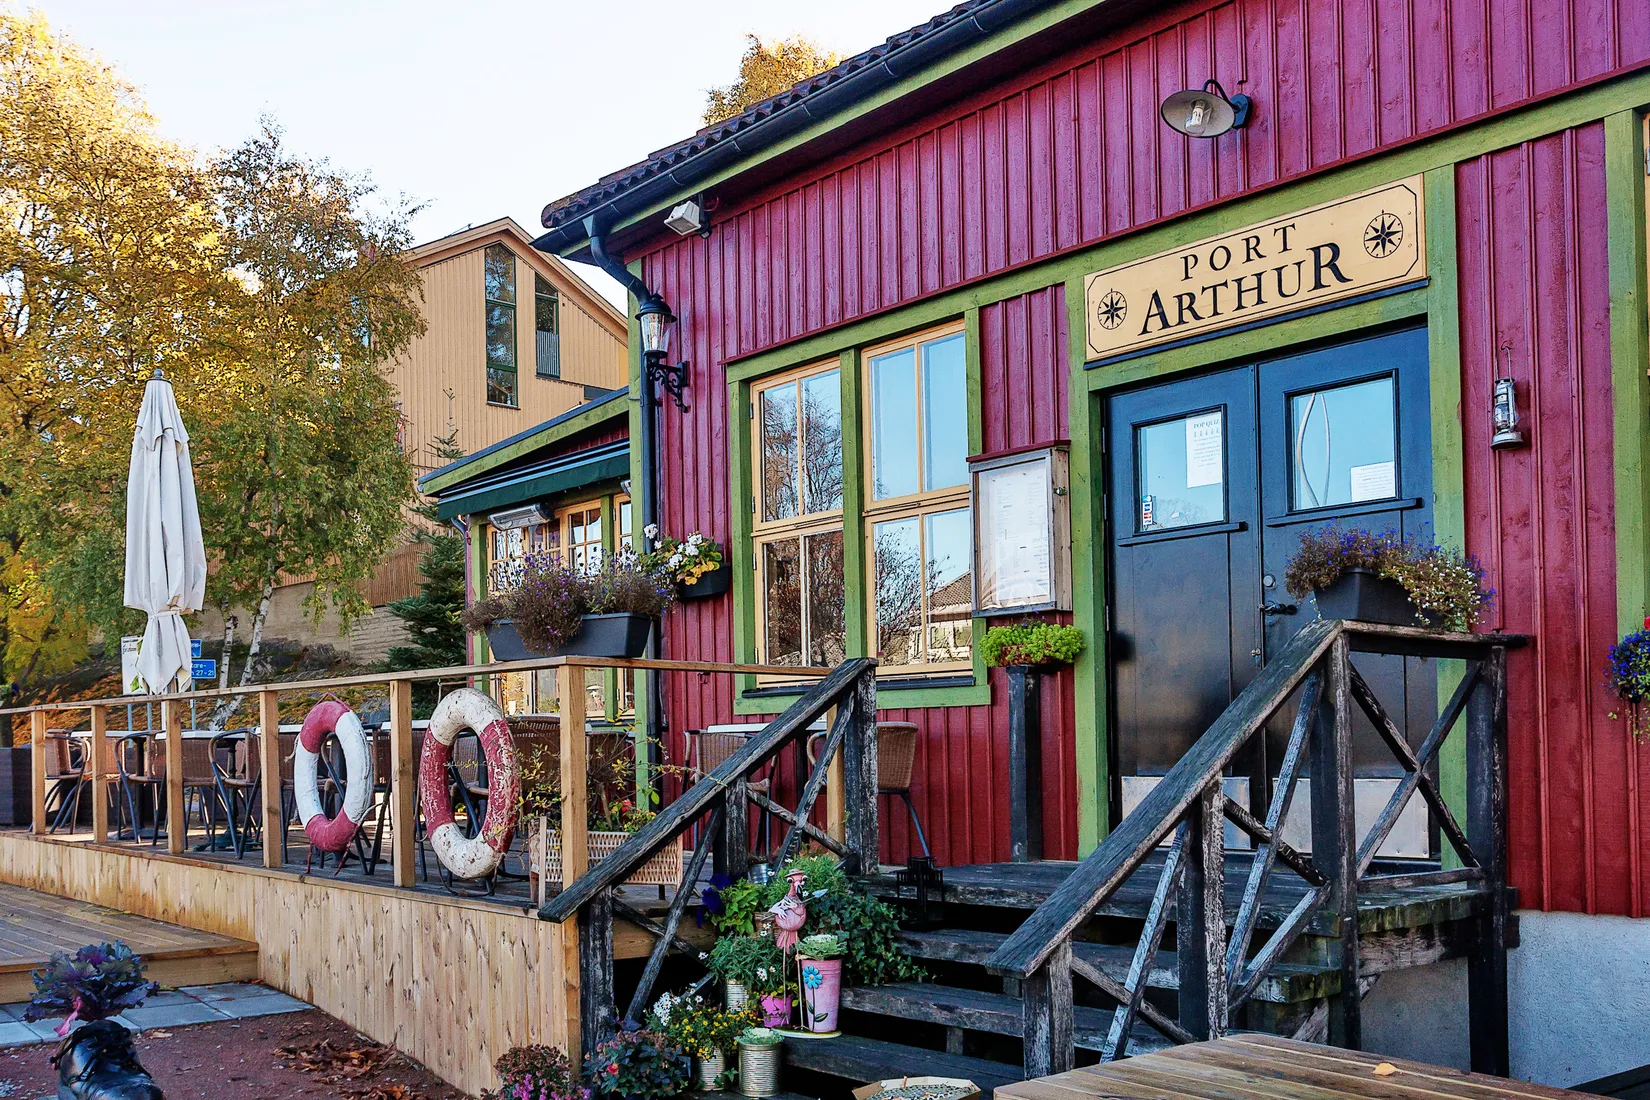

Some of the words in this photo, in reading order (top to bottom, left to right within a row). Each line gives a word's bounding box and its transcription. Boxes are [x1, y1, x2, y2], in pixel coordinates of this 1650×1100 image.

[1181, 223, 1296, 281] PORT
[1138, 242, 1353, 336] ARTHUR
[1206, 419, 1220, 428] QUIZ
